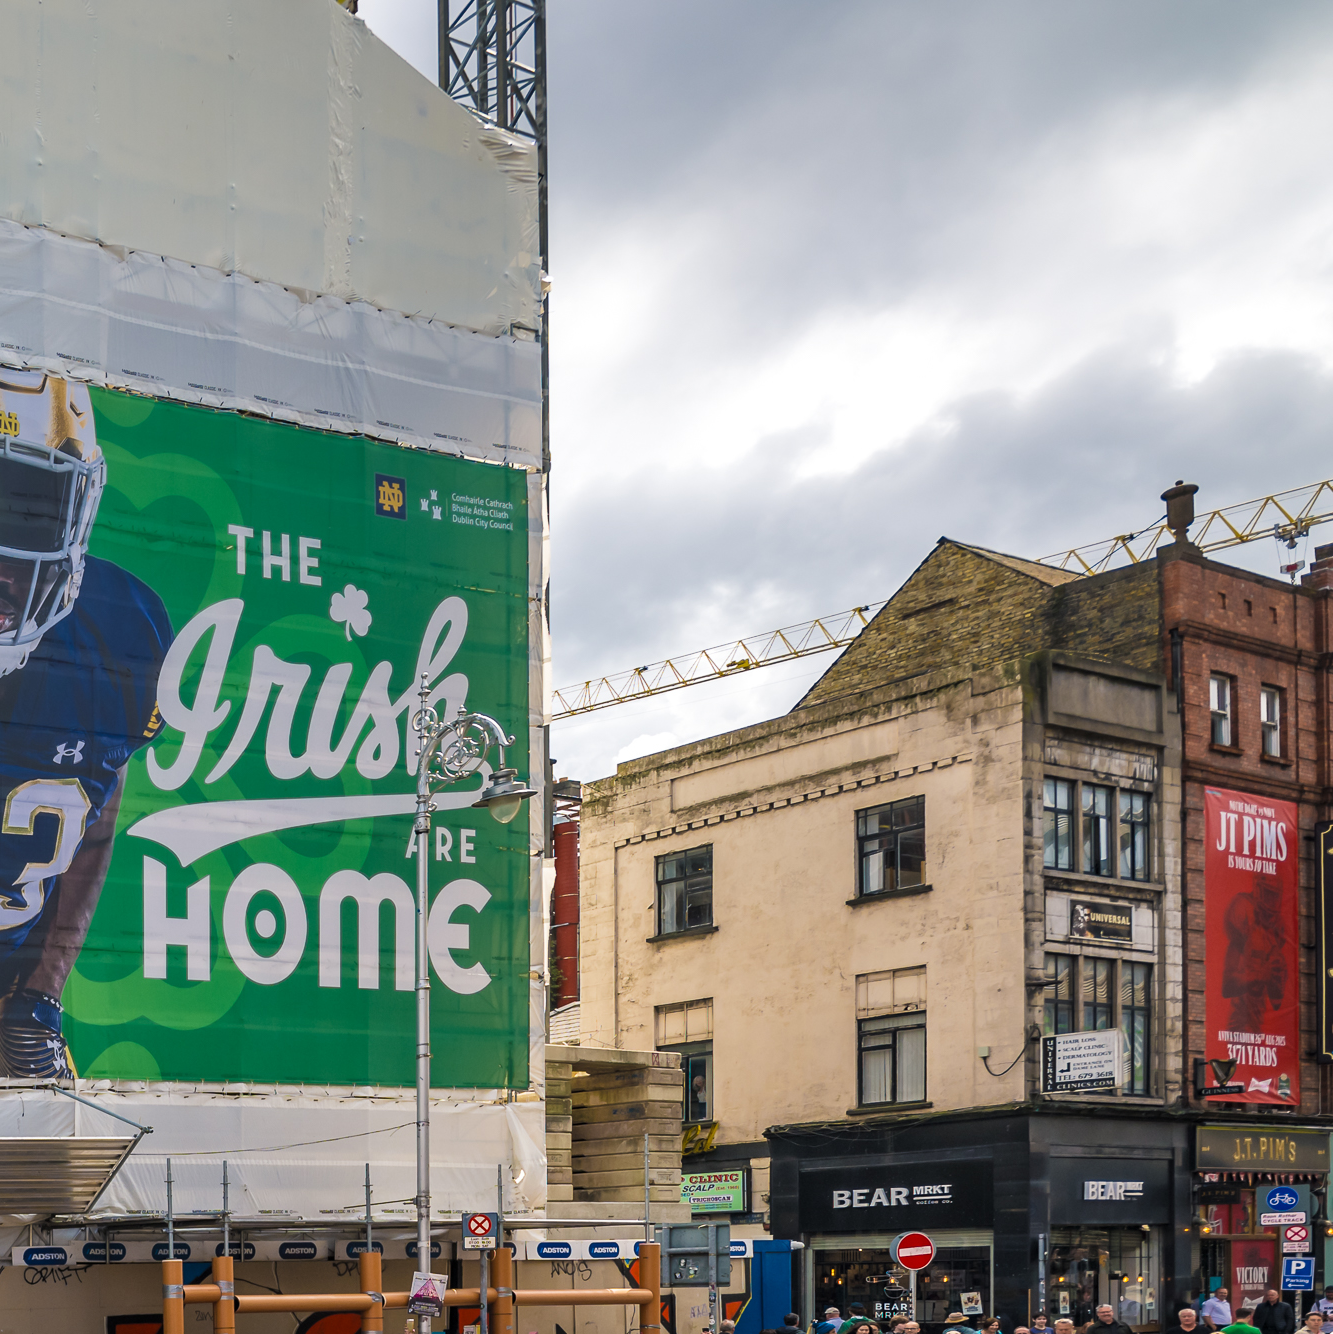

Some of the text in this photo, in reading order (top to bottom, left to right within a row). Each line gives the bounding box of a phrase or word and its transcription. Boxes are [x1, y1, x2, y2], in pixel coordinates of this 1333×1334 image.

[452, 493, 513, 510] Comhairle Cathrach
[452, 504, 509, 519] Bhaile Átha Cliath
[453, 515, 513, 531] Dublin City Council
[228, 524, 322, 586] THE
[145, 596, 483, 792] Irish
[1216, 811, 1287, 861] JT PIMS
[406, 829, 477, 864] ARE
[1228, 855, 1276, 875] IS YOURS TO TAKE
[142, 855, 492, 994] HOME
[1090, 913, 1130, 925] UNIVERSAL
[1063, 1051, 1112, 1060] DERMATOLOGY
[1247, 1046, 1277, 1067] YARDS
[1057, 1080, 1113, 1089] CLINICS.COM
[1202, 1087, 1239, 1095] GUINNESS
[689, 1173, 739, 1184] CLINIC
[682, 1184, 715, 1192] SCALP
[833, 1185, 952, 1209] BEAR MRKT
[31, 1253, 65, 1261] ADSTON
[285, 1247, 314, 1255] ADSTON
[1236, 1267, 1268, 1283] VICTORY
[1291, 1260, 1305, 1274] P
